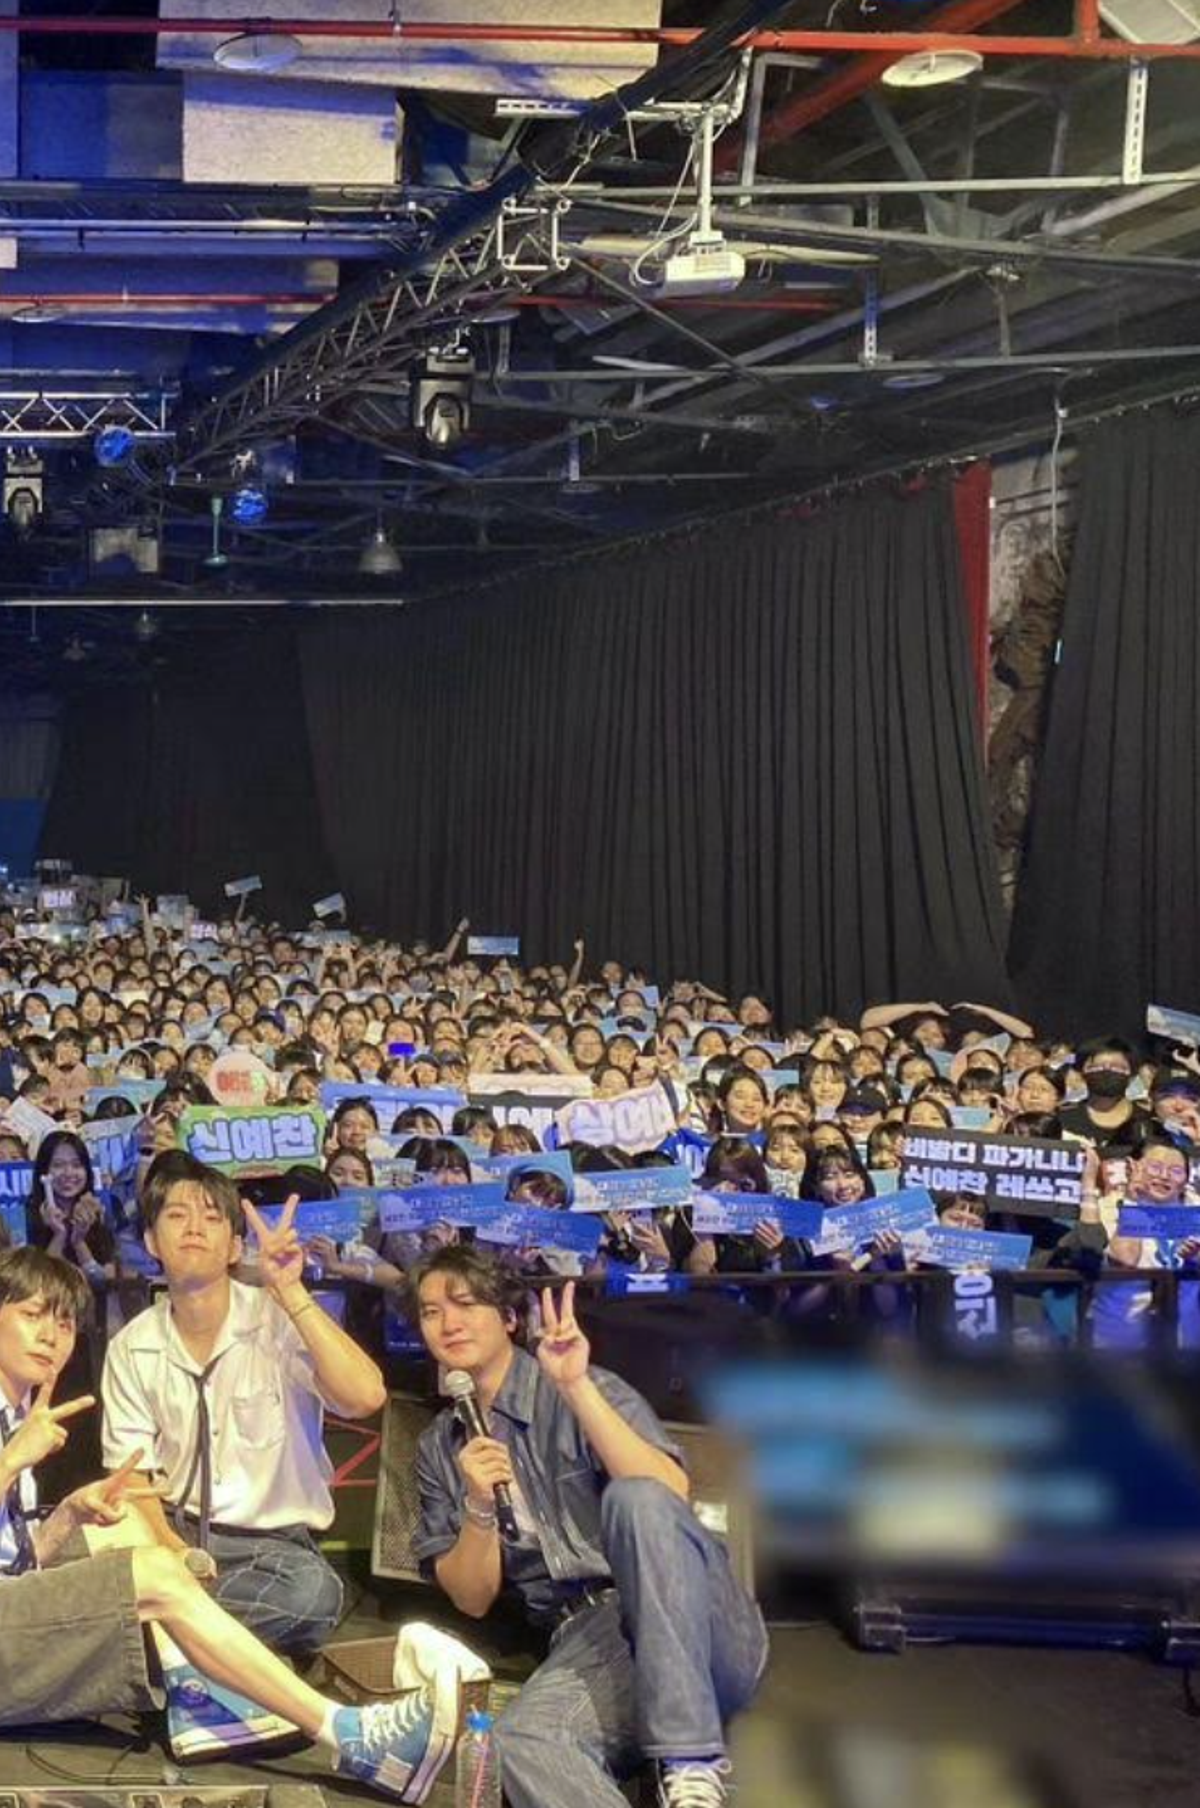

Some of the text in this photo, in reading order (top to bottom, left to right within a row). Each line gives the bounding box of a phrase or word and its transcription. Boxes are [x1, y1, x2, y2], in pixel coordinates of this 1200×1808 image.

[189, 1114, 316, 1163] 신예찬
[982, 1145, 1086, 1173] 파가니니
[904, 1165, 1082, 1204] 신예찬 레쓰고
